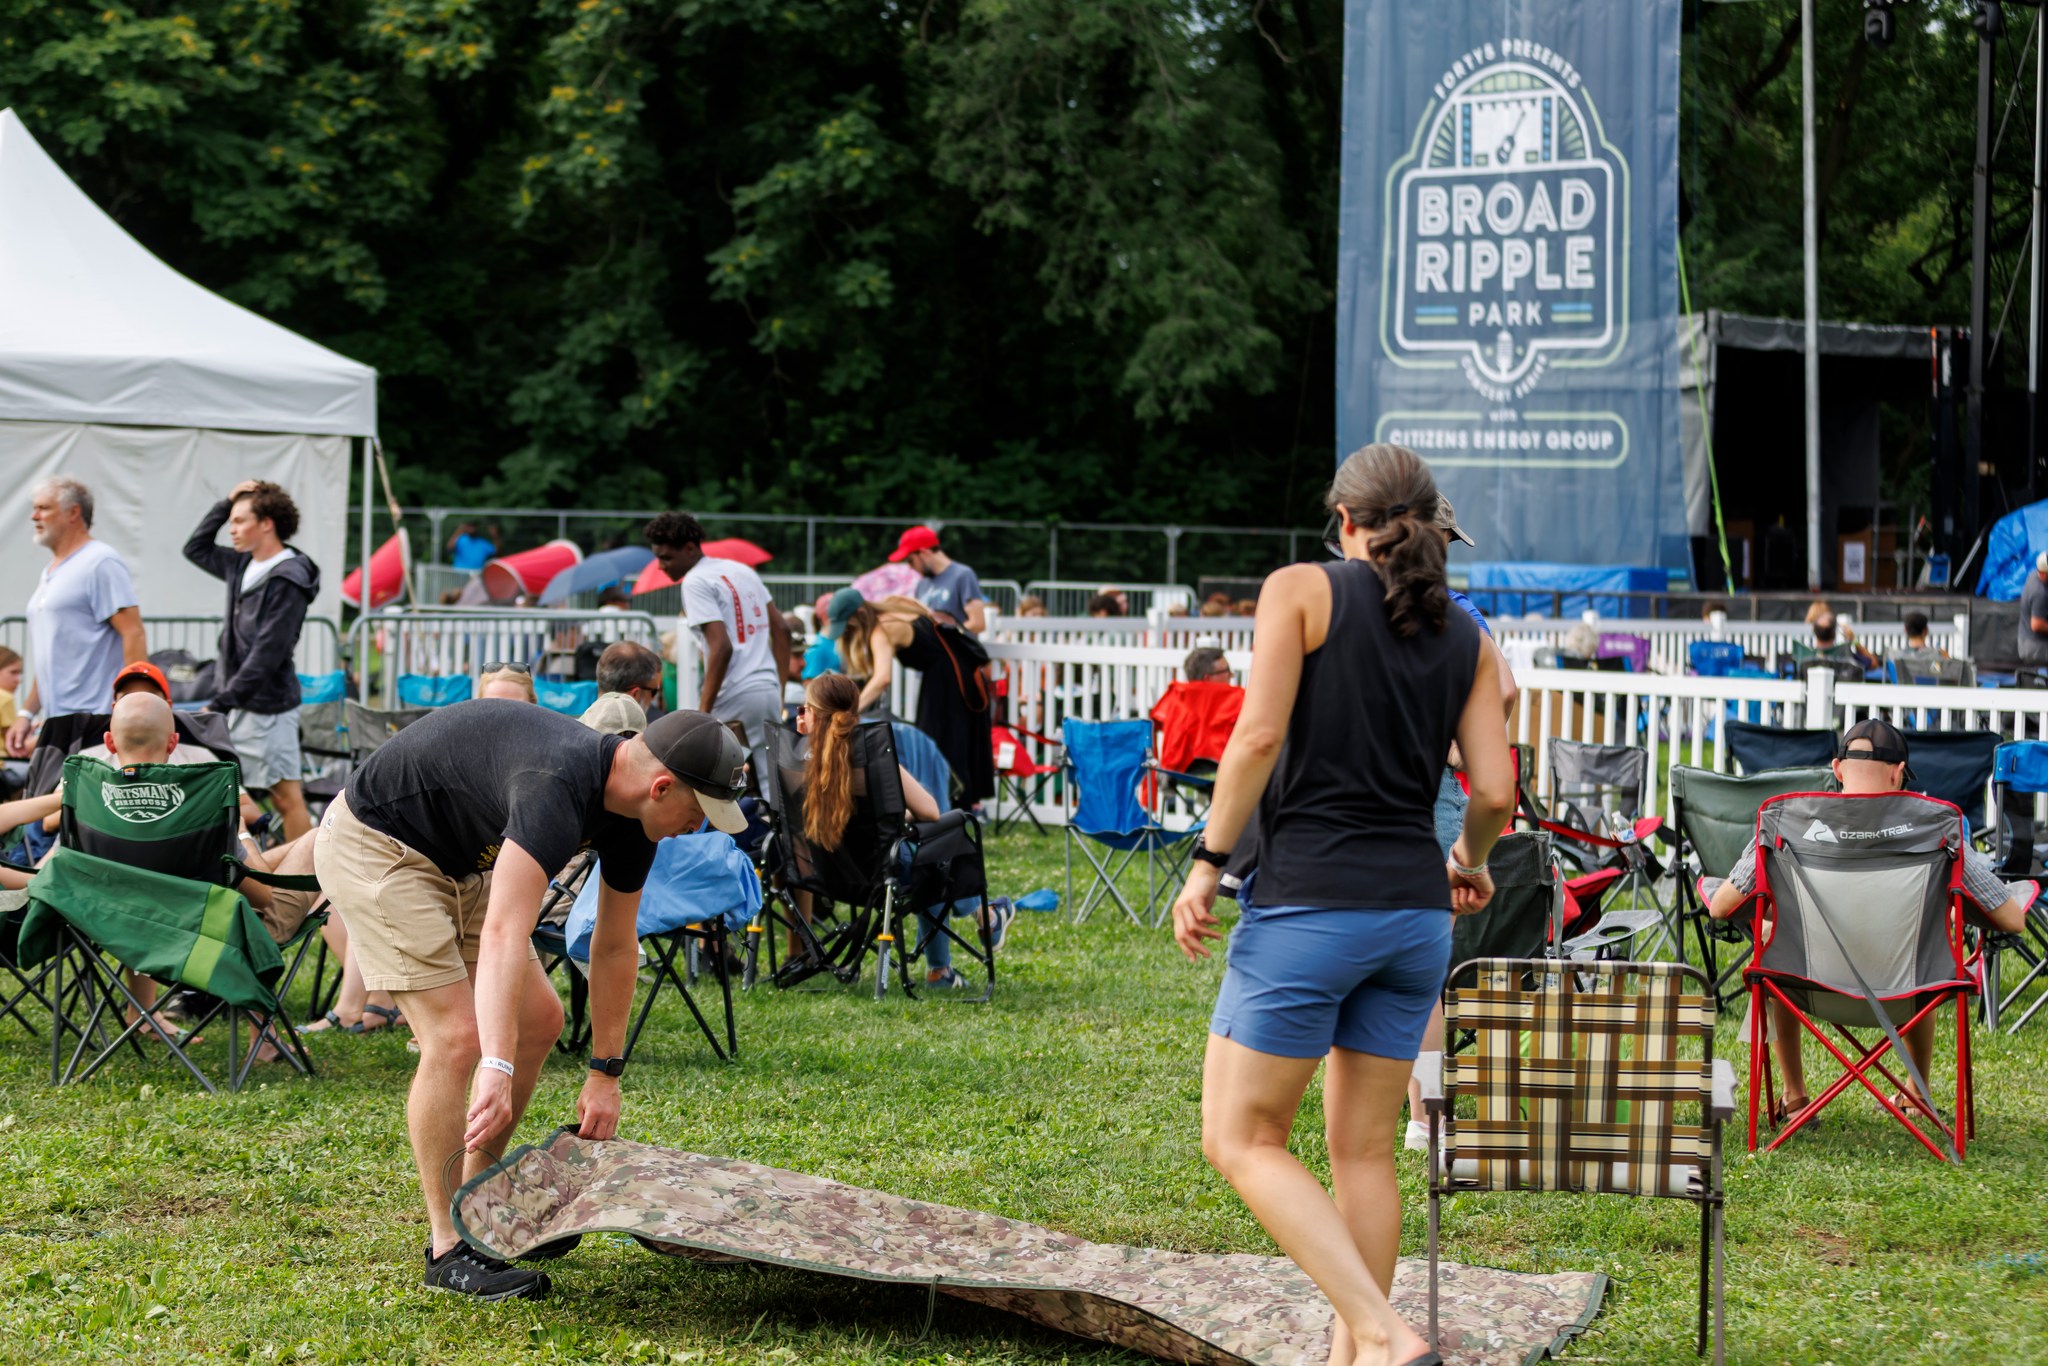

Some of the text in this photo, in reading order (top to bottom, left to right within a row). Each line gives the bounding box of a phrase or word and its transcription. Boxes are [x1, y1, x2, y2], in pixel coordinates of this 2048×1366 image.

[1501, 38, 1581, 88] PRESENTS
[1417, 179, 1596, 236] BROAD
[1415, 236, 1595, 293] RIPPLE
[1469, 301, 1543, 327] PARK
[1389, 429, 1614, 450] CITIZENS ENERGY GROUP
[1840, 825, 1914, 840] OZARK TRAIL
